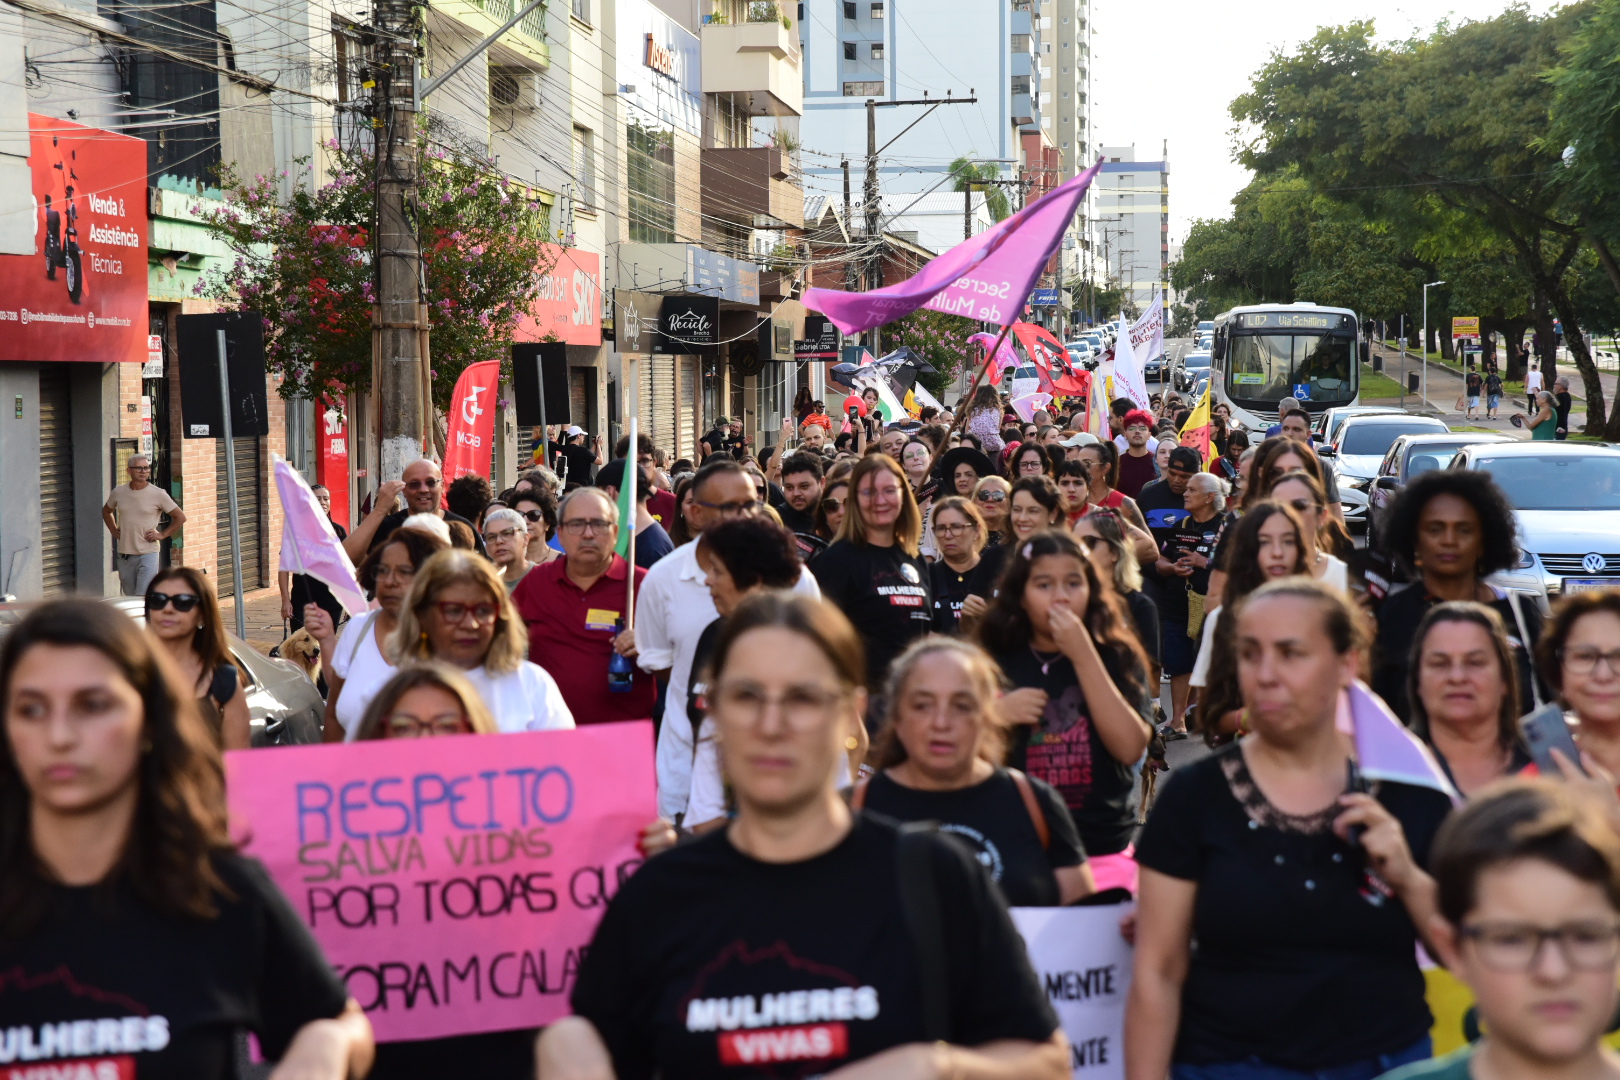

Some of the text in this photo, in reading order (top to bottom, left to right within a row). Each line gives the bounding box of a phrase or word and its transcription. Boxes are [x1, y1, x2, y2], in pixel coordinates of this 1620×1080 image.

[88, 193, 126, 217] Venda &
[89, 223, 139, 248] Assistência
[89, 252, 123, 275] Técnica
[572, 268, 597, 327] SKY
[669, 313, 713, 332] Recicle
[1278, 315, 1292, 326] Via
[1292, 315, 1328, 327] Schilling
[795, 343, 819, 351] Gabriel
[331, 438, 346, 454] FIBRA
[894, 596, 920, 606] VIVAS
[295, 765, 575, 843] RESPEITO
[298, 827, 554, 883] SALVA VIDAS
[306, 882, 399, 928] POR
[416, 872, 557, 923] TODAS
[333, 947, 588, 1013] ORAM CALA
[686, 985, 880, 1032] MULHERES
[0, 1014, 171, 1064] ULHERES
[732, 1026, 834, 1064] VIVAS
